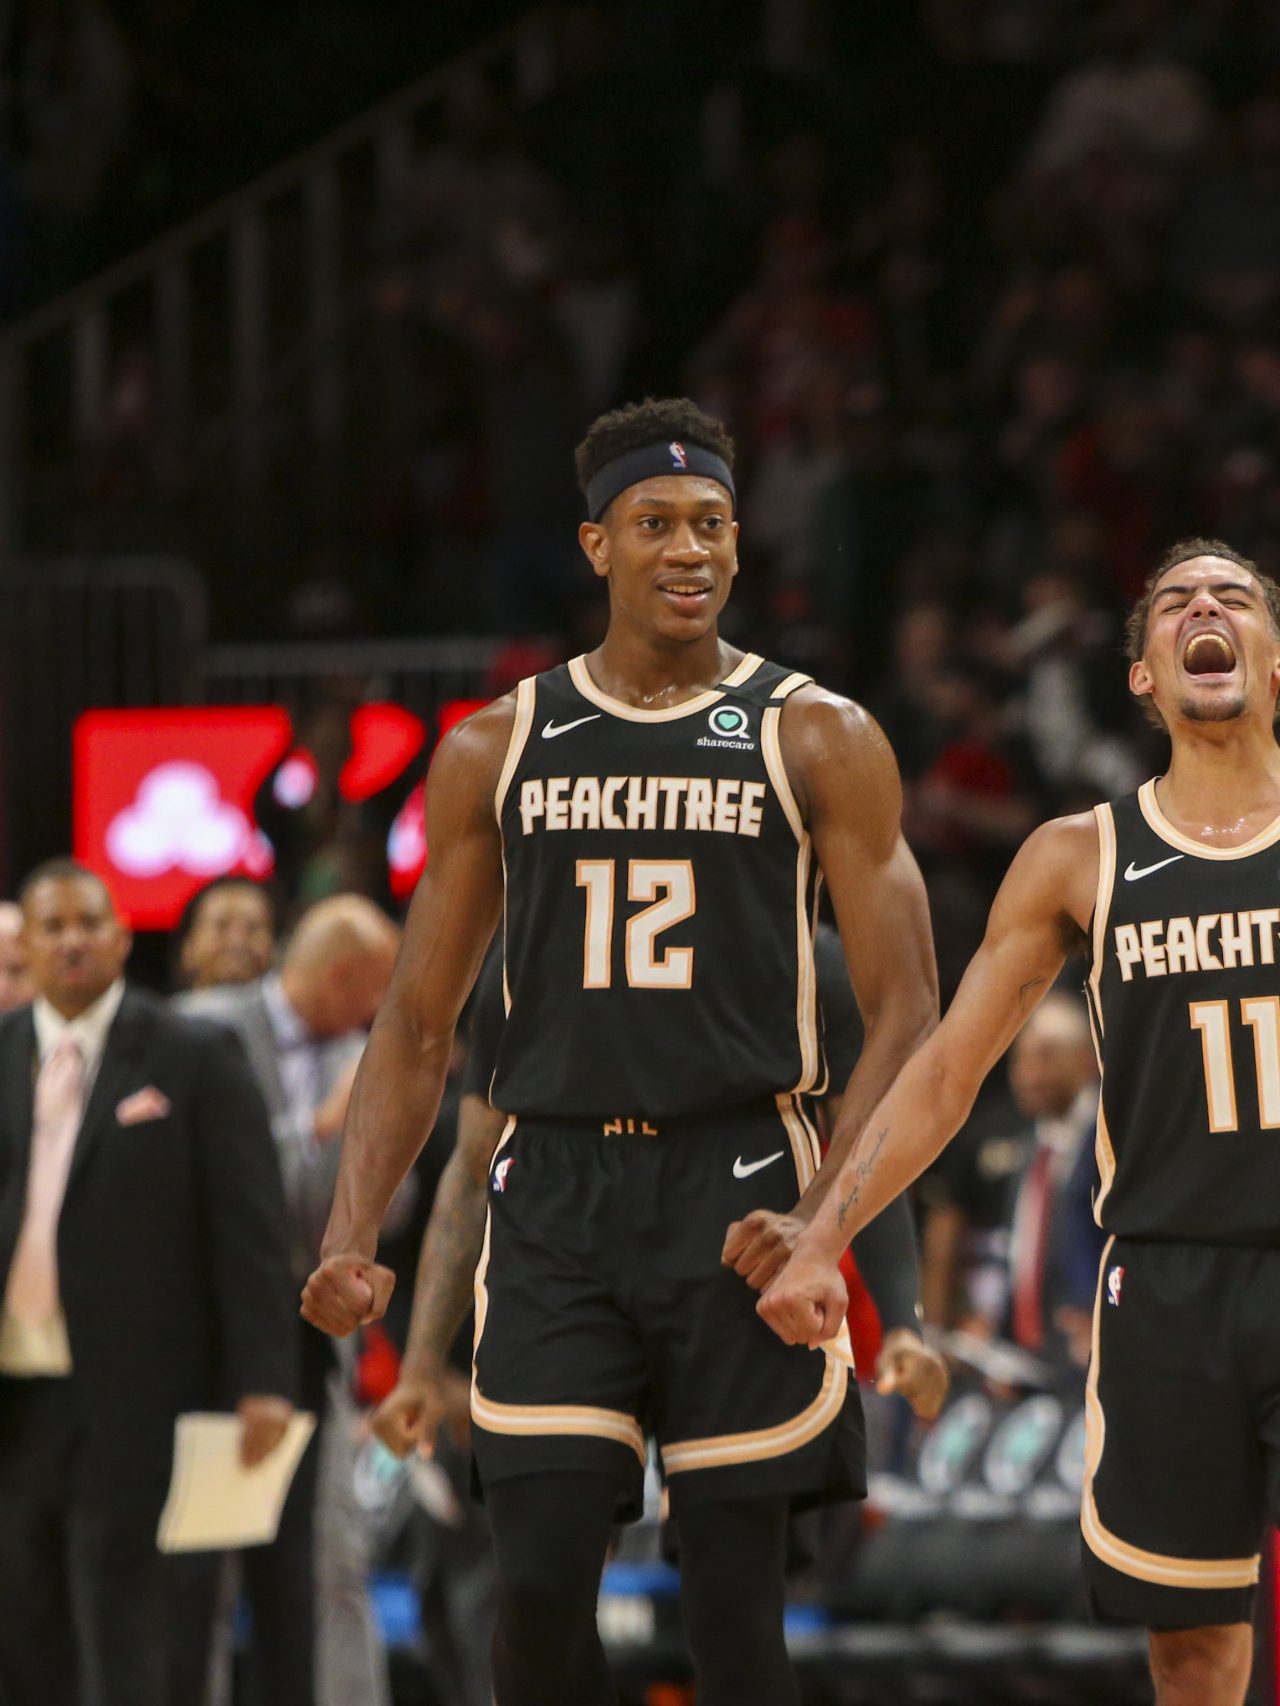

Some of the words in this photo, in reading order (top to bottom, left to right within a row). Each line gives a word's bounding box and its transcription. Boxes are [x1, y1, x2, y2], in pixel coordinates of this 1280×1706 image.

[696, 736, 755, 751] sharecare
[519, 776, 766, 838] PEACHTREE
[575, 858, 696, 990] 12
